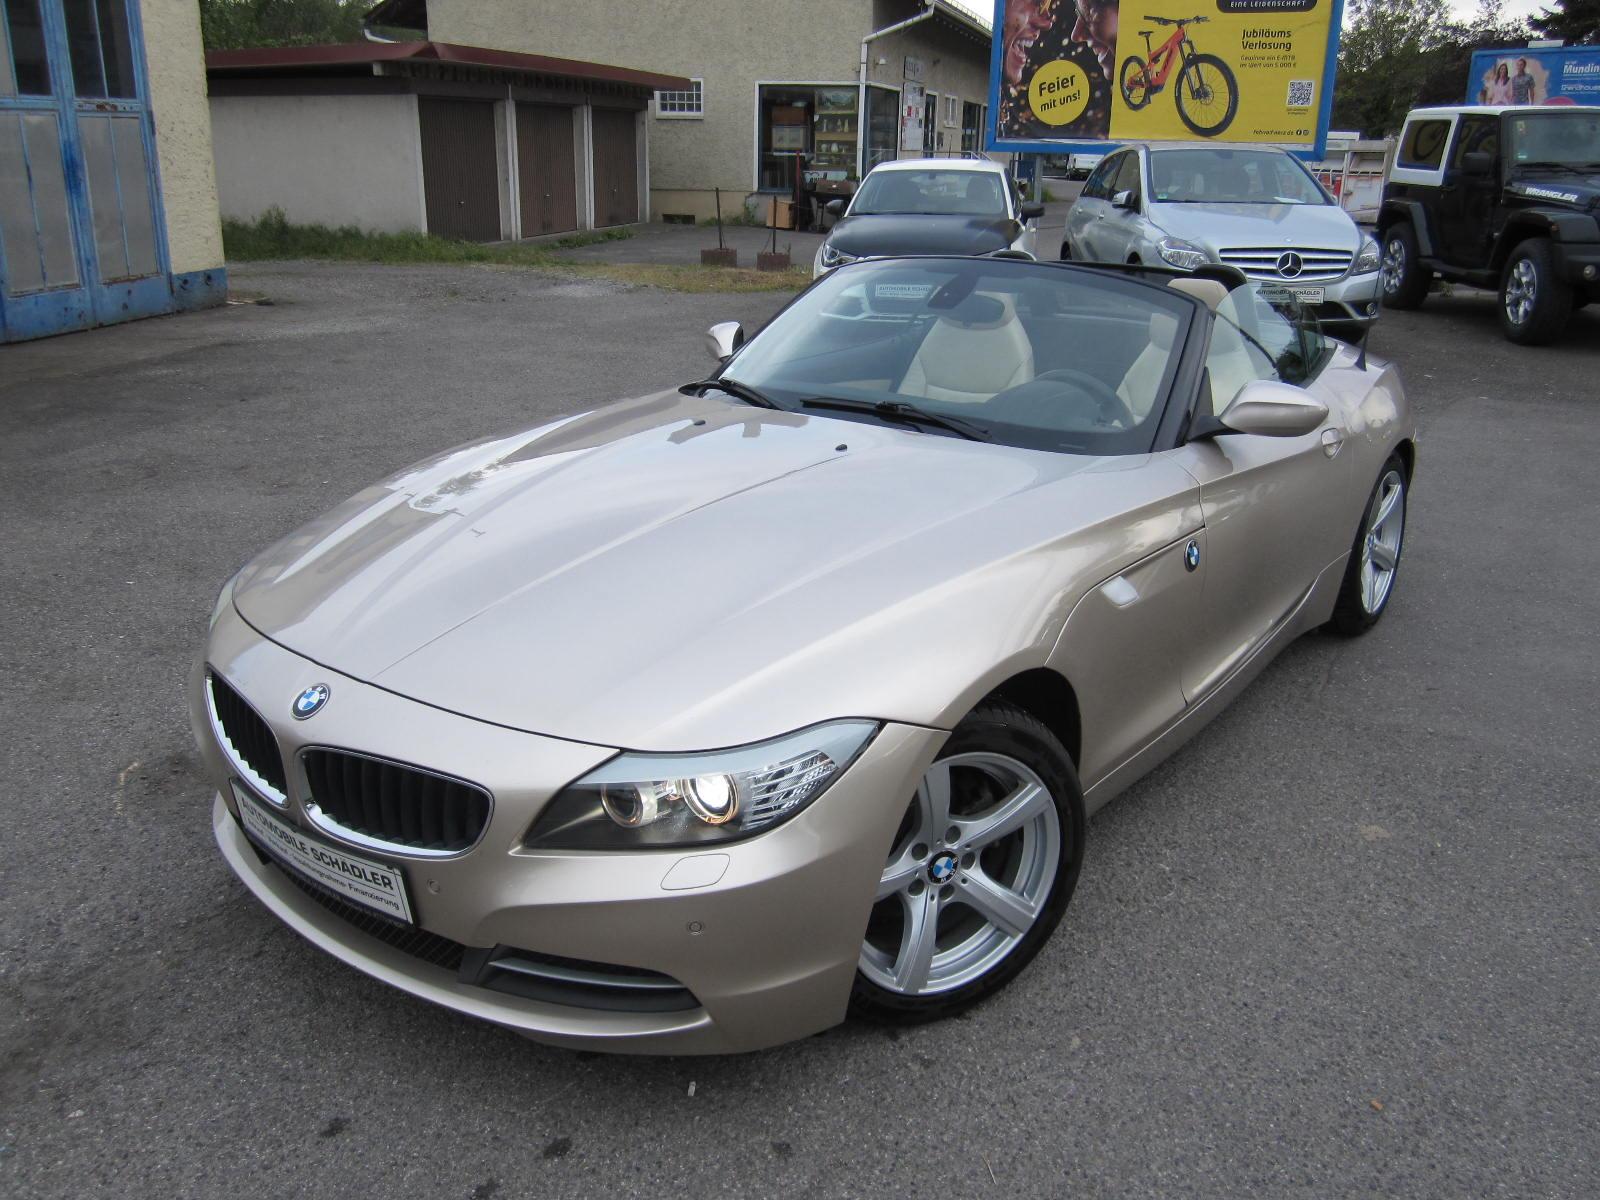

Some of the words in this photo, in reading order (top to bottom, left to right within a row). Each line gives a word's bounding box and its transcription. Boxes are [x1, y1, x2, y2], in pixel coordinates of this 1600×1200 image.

[1250, 0, 1306, 8] LEIDENSCHAFT
[1242, 29, 1292, 40] Jubiläums
[1241, 40, 1292, 51] Verlosung
[1038, 75, 1075, 97] Feier
[1040, 99, 1057, 112] mit
[1059, 89, 1080, 105] uns!
[1525, 187, 1578, 202] WRANGLER
[241, 797, 309, 855] AUTOMOBILE
